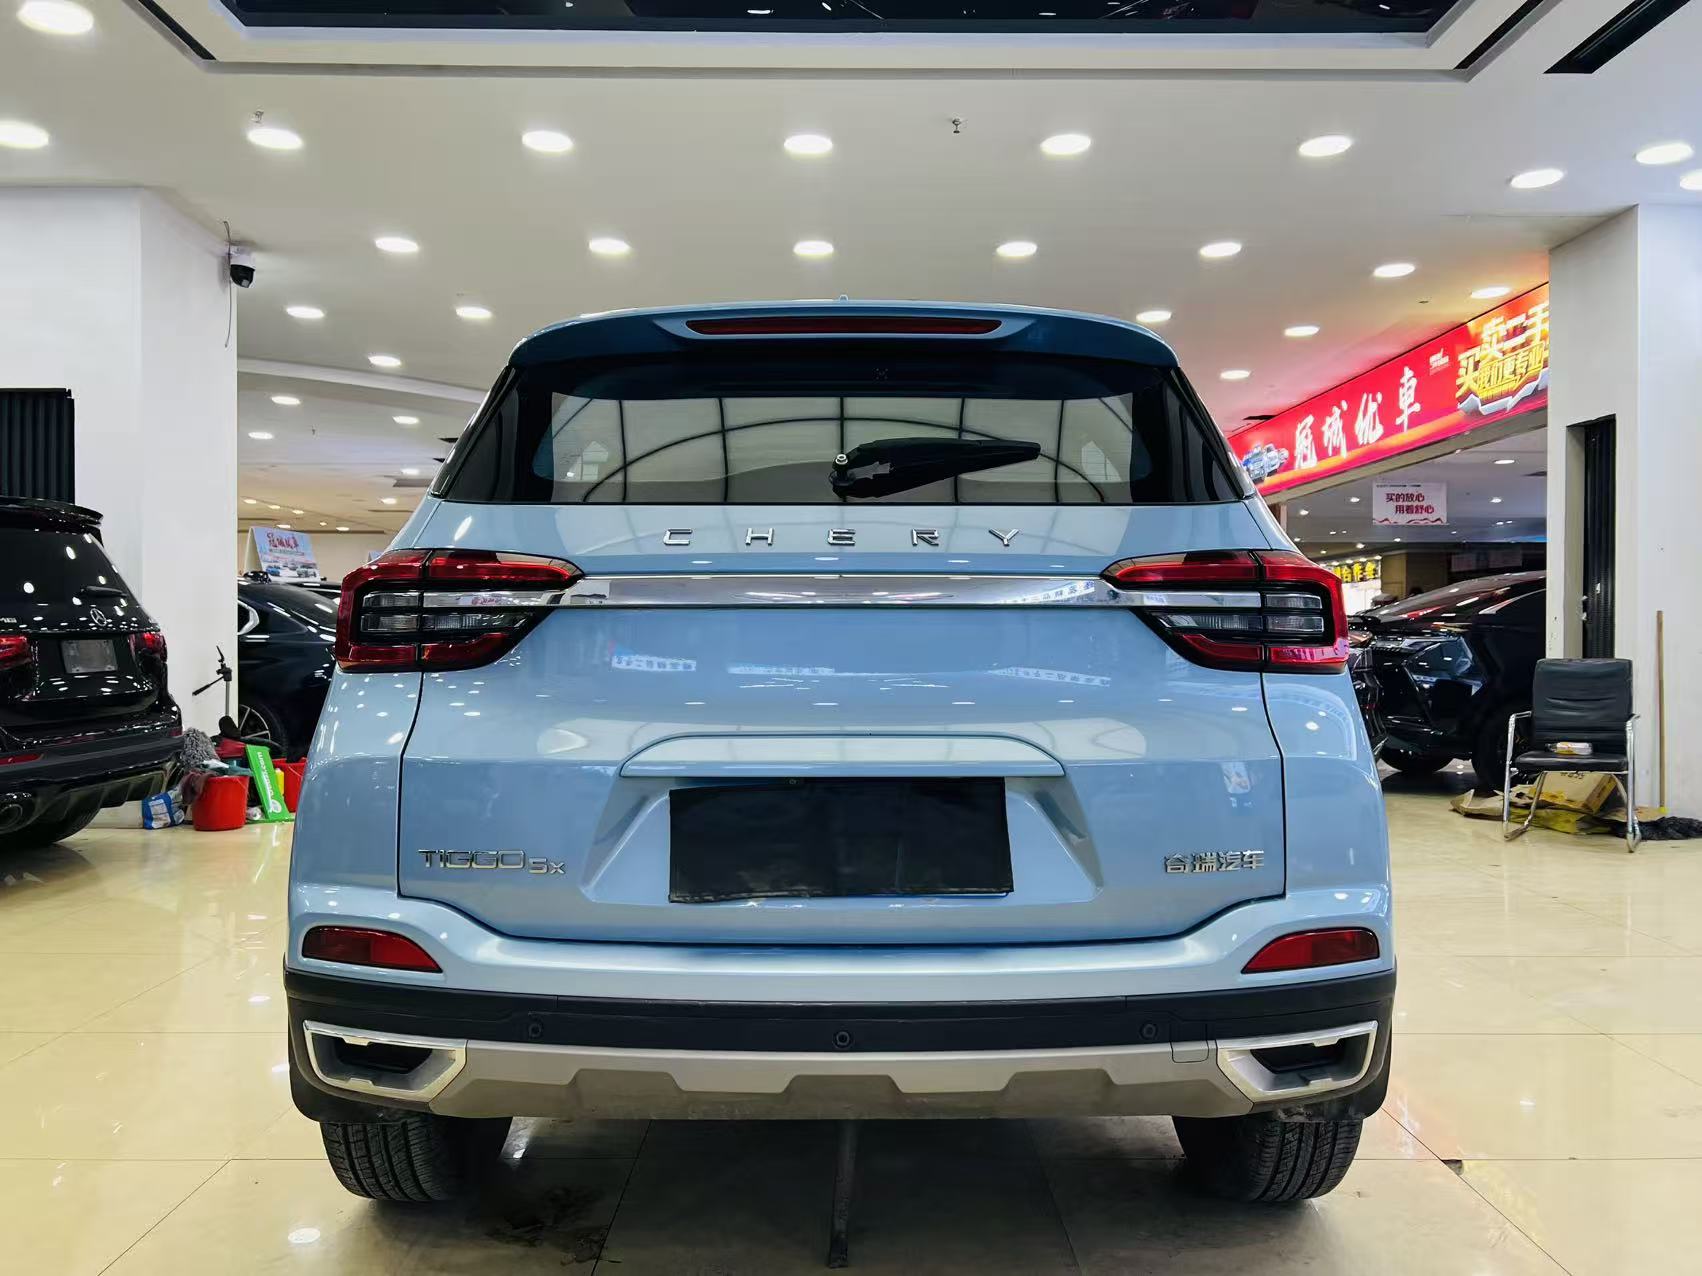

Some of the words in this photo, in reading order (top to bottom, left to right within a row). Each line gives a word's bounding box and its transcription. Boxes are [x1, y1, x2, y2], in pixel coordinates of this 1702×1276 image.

[1456, 302, 1549, 398] 买卖二手
[1385, 493, 1425, 503] 买的放心
[664, 528, 1019, 547] CHERY
